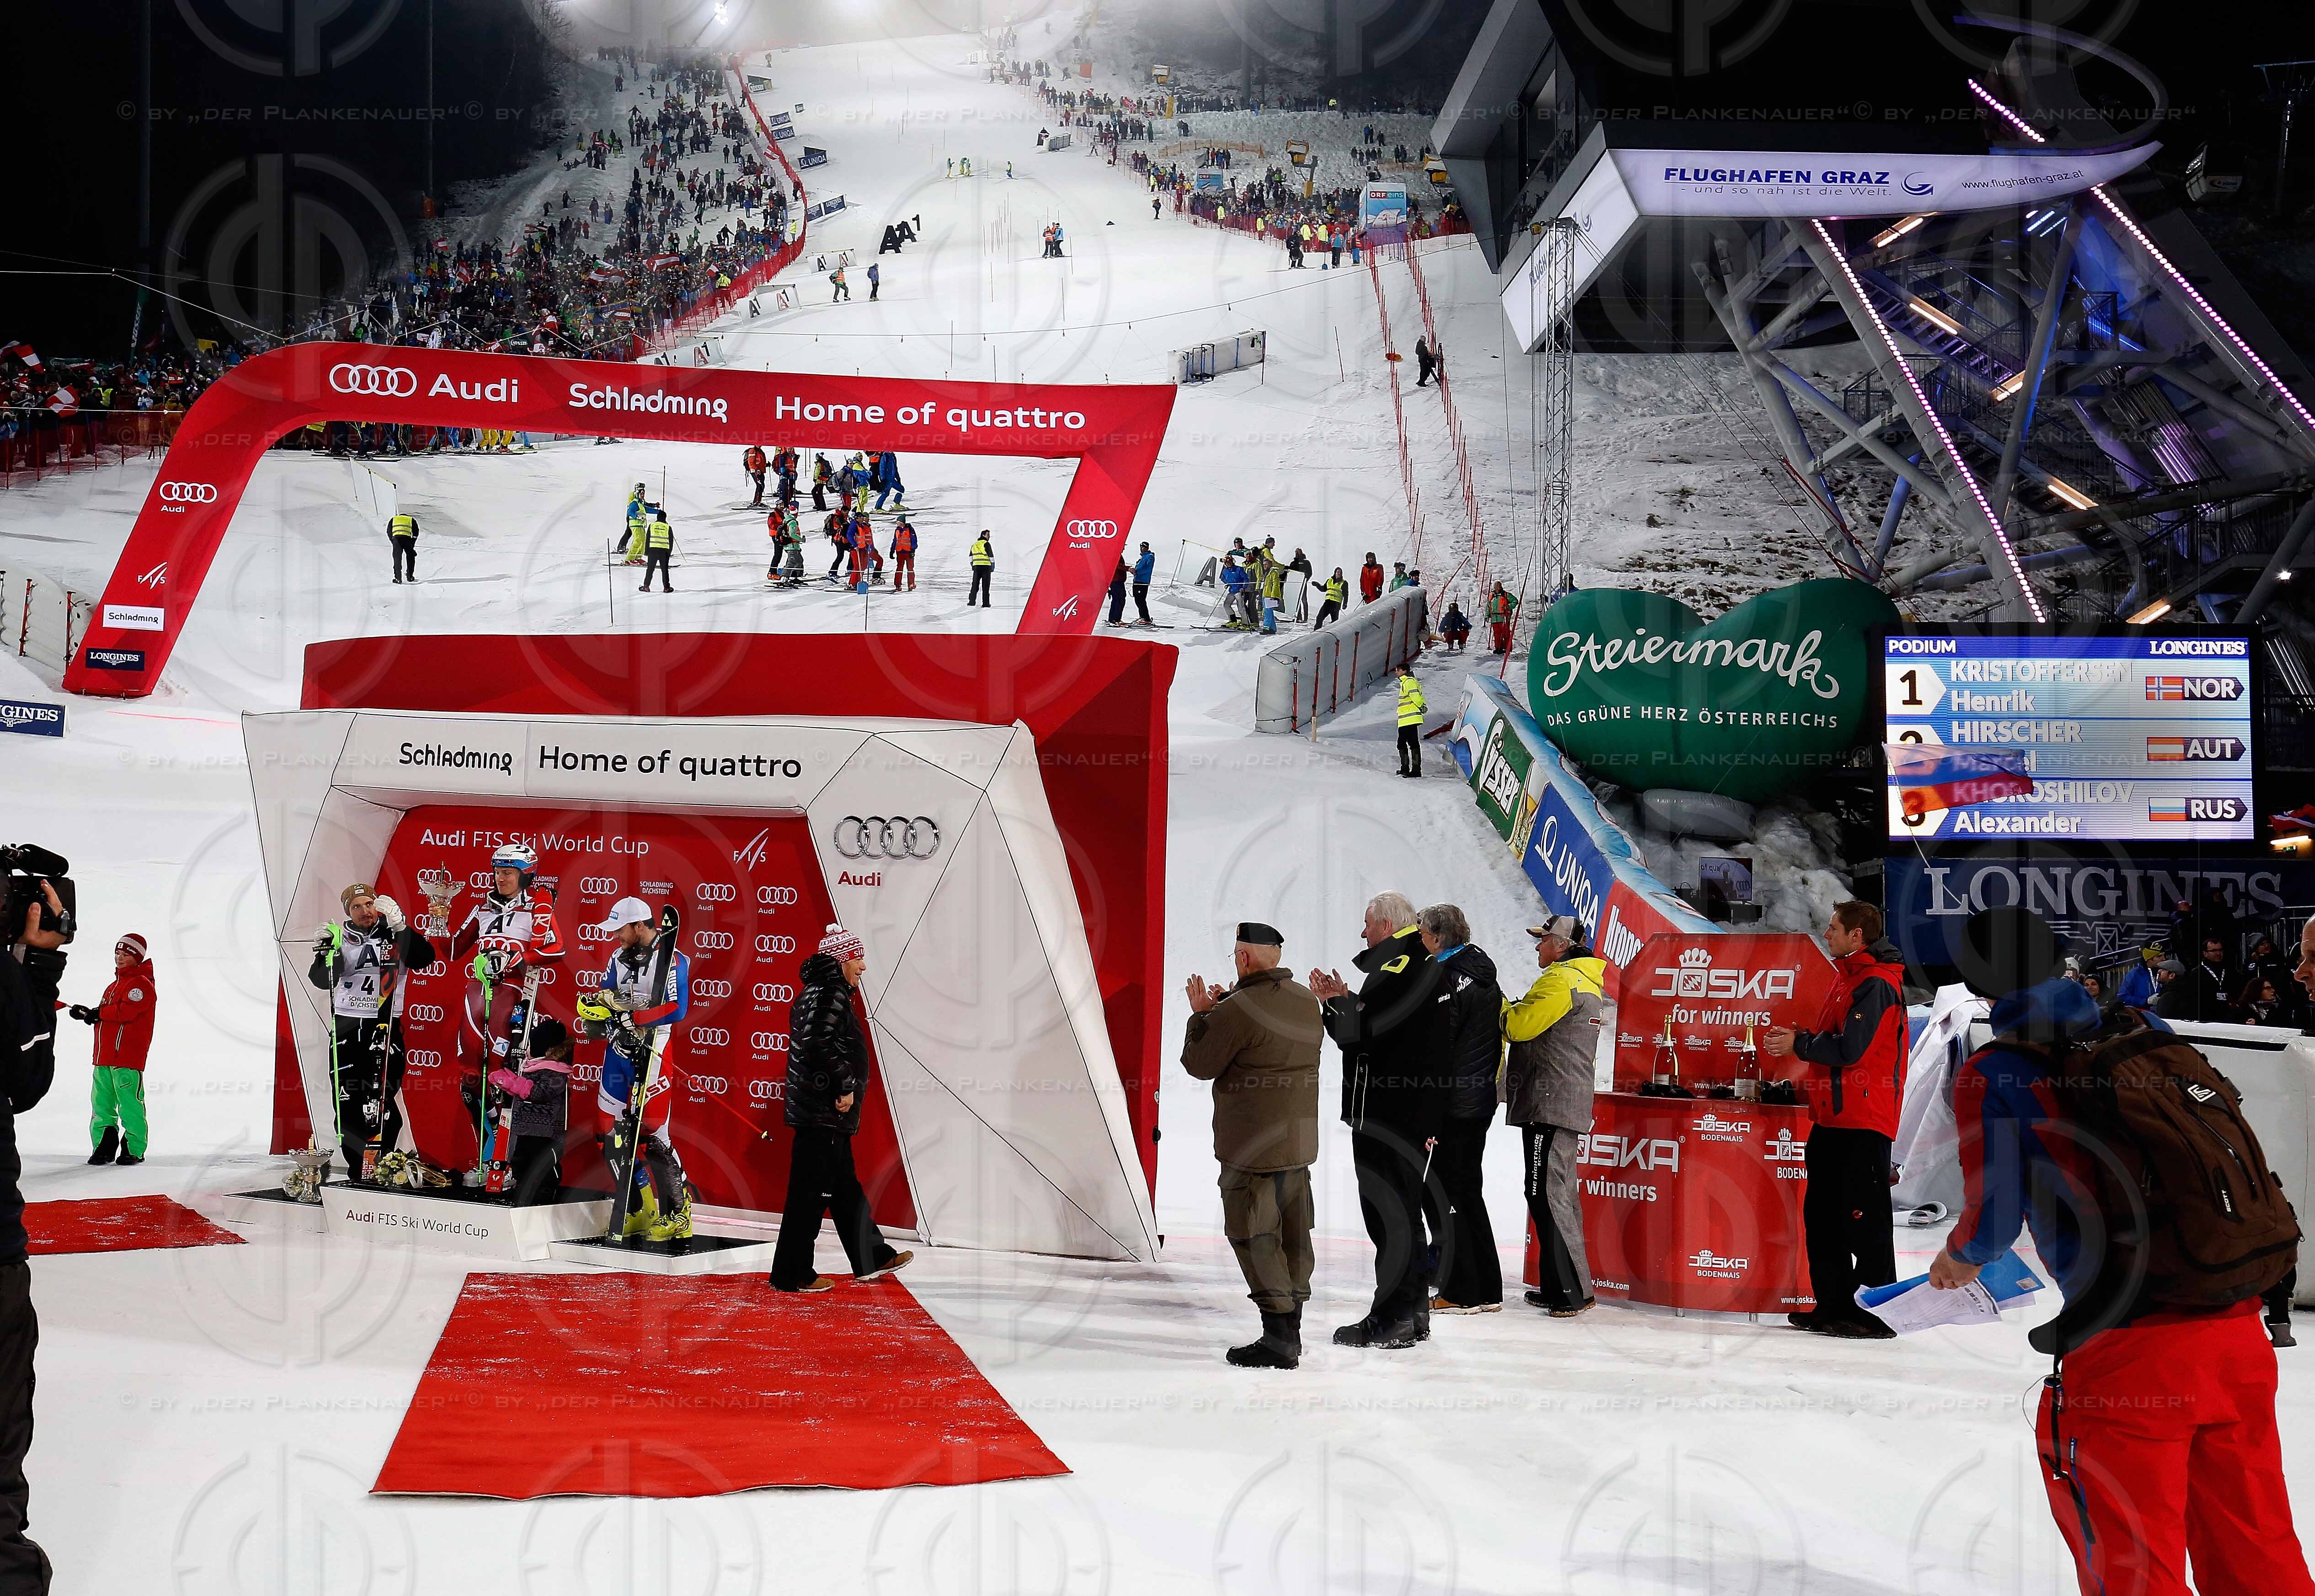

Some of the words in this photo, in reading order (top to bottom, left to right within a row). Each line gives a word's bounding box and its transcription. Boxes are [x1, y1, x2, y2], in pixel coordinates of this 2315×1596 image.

[808, 154, 827, 166] UNIQA
[1664, 168, 1811, 184] FLUGHAFEN
[1821, 171, 1890, 184] GRAZ
[1961, 169, 2084, 189] www.flughafen-graz.at
[1694, 185, 1723, 193] und
[1757, 186, 1784, 195] nah
[1792, 187, 1810, 195] ist
[1819, 187, 1842, 196] die
[1850, 187, 1892, 197] Welt.
[428, 373, 519, 403] Audi
[569, 383, 728, 423] Schladming
[776, 396, 885, 424] Home
[897, 402, 937, 426] of
[946, 405, 1086, 432] quattro
[160, 505, 185, 513] Audi
[108, 612, 159, 624] Schladming
[90, 652, 139, 662] LONGINES
[1888, 639, 1957, 654] PODIUM
[2150, 640, 2246, 655] LONGINES
[1543, 628, 1839, 699] Steiermark
[1900, 669, 1923, 706] 1
[1951, 660, 2133, 682] KRISTOFFERSEN
[1952, 689, 2036, 712] Henrik
[2184, 678, 2235, 698] NOR
[1547, 711, 1571, 727] DAS
[1578, 705, 1632, 723] GRÜNE
[1641, 705, 1689, 721] HERZ
[1699, 707, 1838, 728] ÖSTERREICHS
[1952, 721, 2083, 743] HIRSCHER
[2188, 739, 2235, 758] AUT
[399, 742, 512, 776] Schladming
[539, 745, 628, 773] Home
[638, 750, 670, 774] of
[678, 754, 802, 782] quattro
[1954, 811, 2082, 834] Alexander
[2192, 799, 2236, 819] RUS
[421, 829, 465, 847] Audi
[473, 831, 503, 848] FIS
[510, 833, 537, 850] Ski
[543, 834, 603, 853] World
[611, 836, 649, 858] Cup
[837, 871, 882, 886] Audi
[1556, 843, 1599, 940] UNIQA
[485, 912, 516, 935] A1
[360, 975, 375, 995] 4
[667, 969, 678, 1002] RUSSIA
[1651, 968, 1795, 1000] JOSKA
[1672, 1004, 1698, 1024] for
[1702, 1005, 1771, 1027] winners
[1692, 1119, 1750, 1133] JOSKA
[1701, 1133, 1743, 1143] BODENMAIS
[1586, 1175, 1657, 1202] winners
[2221, 1190, 2231, 1212] SCOTT
[346, 1210, 374, 1223] Audi
[378, 1213, 397, 1226] FIS
[401, 1216, 419, 1229] Ski
[422, 1218, 460, 1234] World
[465, 1224, 488, 1240] Cup
[1688, 1256, 1748, 1270] JOSKA
[1697, 1270, 1740, 1279] BODENMAIS
